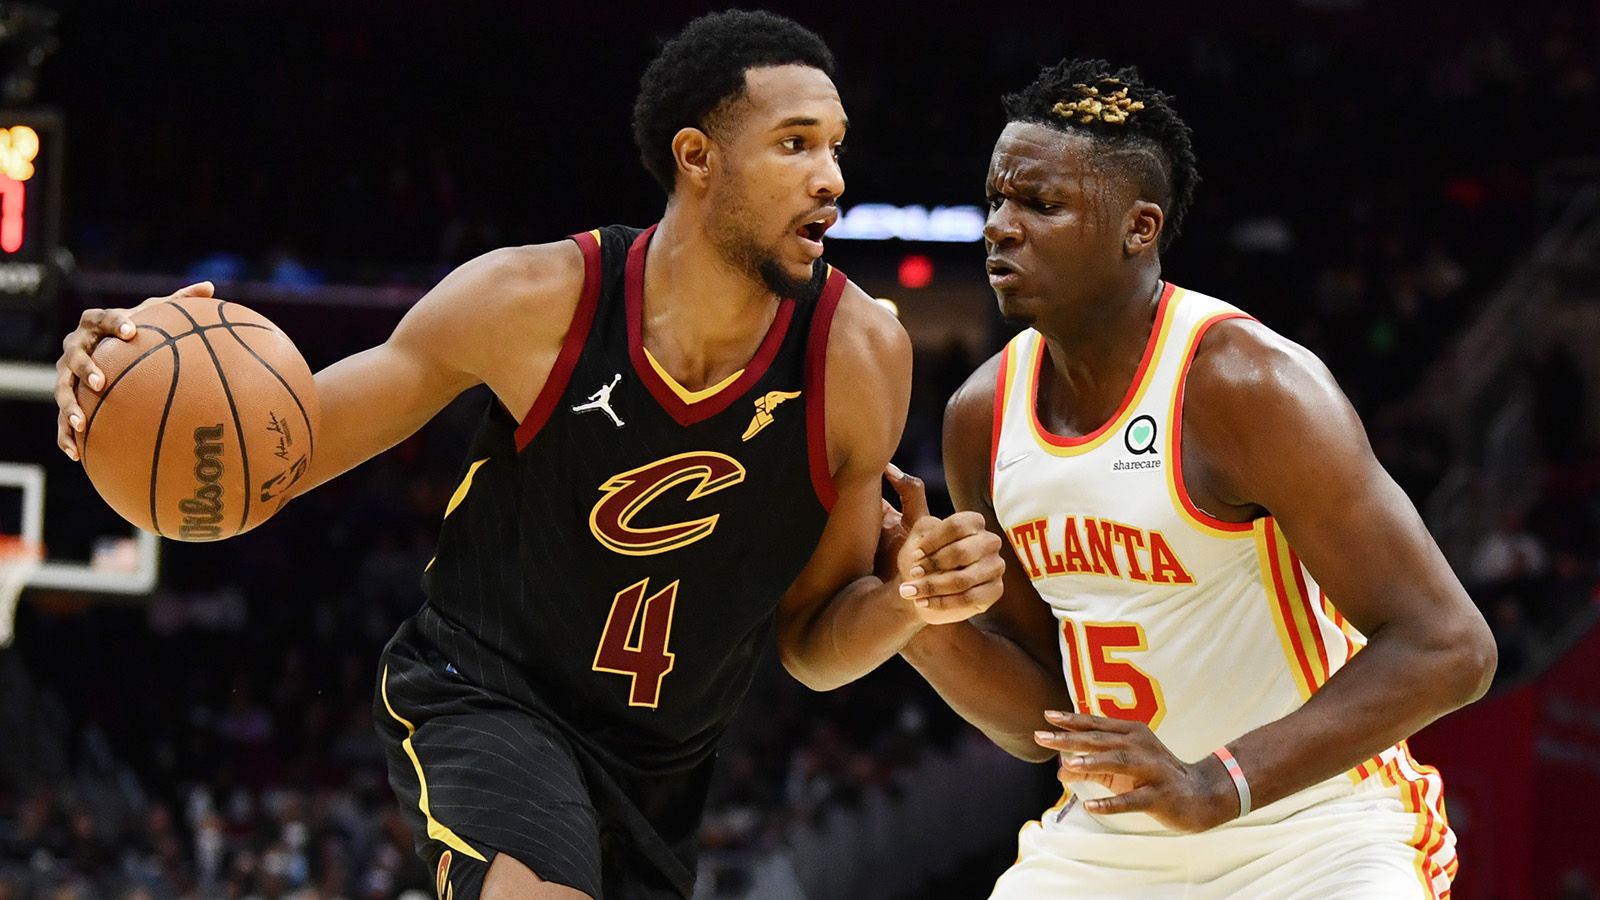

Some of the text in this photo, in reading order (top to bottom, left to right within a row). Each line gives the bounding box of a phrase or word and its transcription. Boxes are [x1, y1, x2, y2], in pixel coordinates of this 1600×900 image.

[589, 450, 747, 556] C
[1112, 459, 1161, 471] sharecare
[1006, 514, 1197, 586] TLANTA
[592, 576, 680, 708] 4
[1060, 617, 1167, 733] 15
